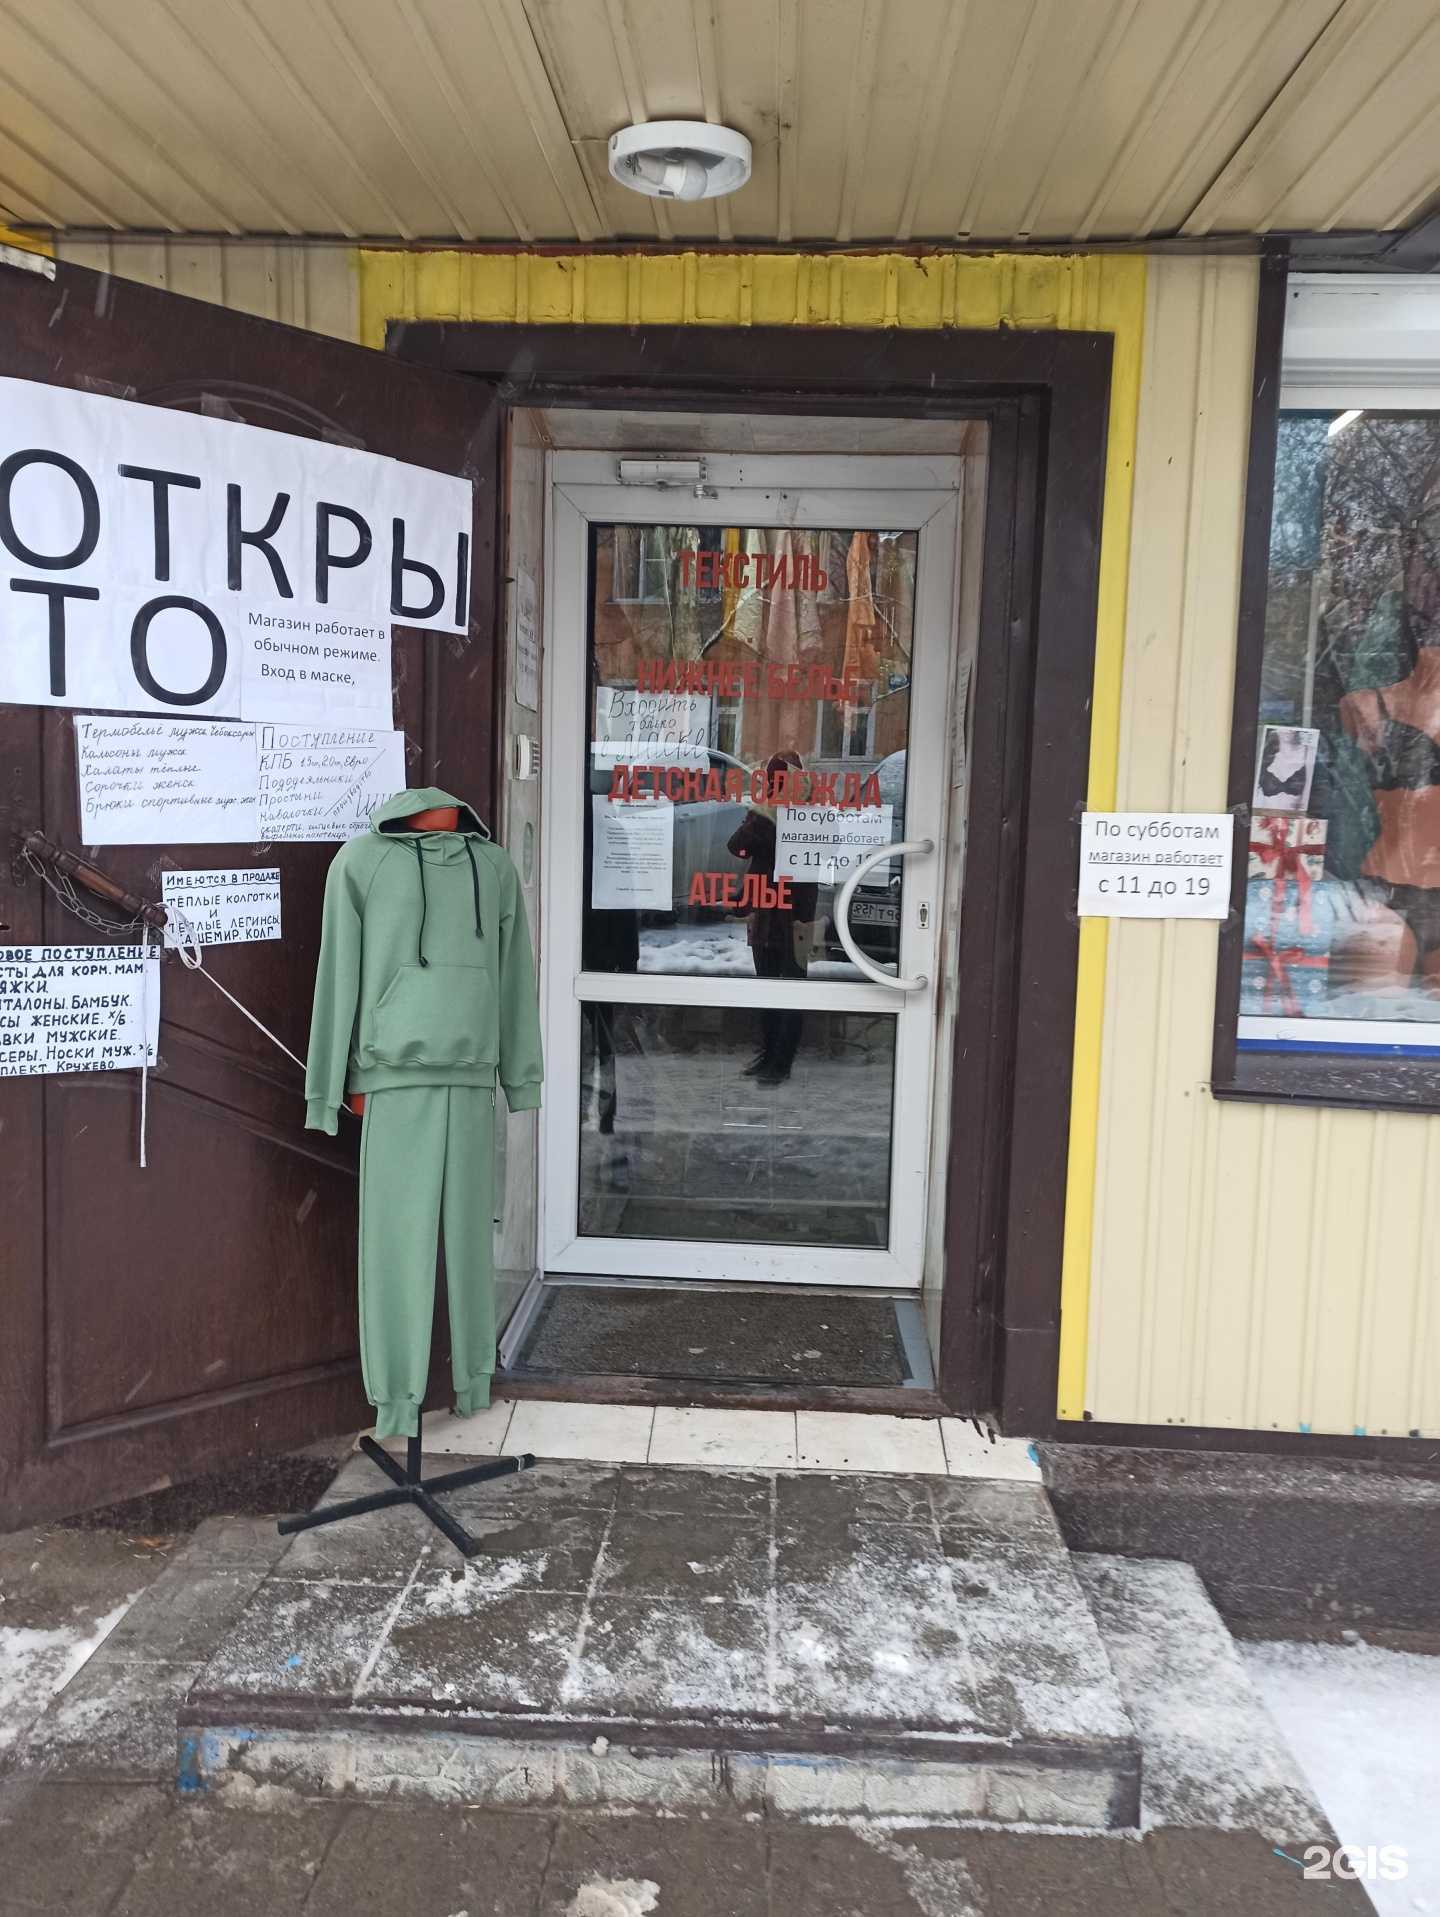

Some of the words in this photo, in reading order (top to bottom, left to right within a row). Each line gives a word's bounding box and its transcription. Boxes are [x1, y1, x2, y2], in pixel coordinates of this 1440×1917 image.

[0, 449, 468, 627] ОТКРЫ
[678, 551, 828, 592] ТЕКСТИЛЬ
[248, 612, 310, 631] Магазин
[315, 622, 375, 638] работает
[378, 630, 385, 640] в
[10, 577, 227, 706] ТО
[254, 638, 319, 656] обычном
[323, 647, 380, 662] режиме.
[261, 663, 295, 681] Вход
[299, 670, 307, 680] в
[311, 670, 355, 687] маске,
[637, 657, 760, 699] НИЖНЕЕ
[766, 663, 860, 703] БЕЛЬЕ
[608, 690, 698, 720] Входить
[259, 752, 293, 771] КПБ
[608, 764, 743, 803] ДЕТСКАЯ
[751, 768, 882, 811] ОДЕЖДА
[786, 808, 807, 822] По
[782, 831, 829, 842] магазин
[832, 832, 886, 845] работает
[1096, 820, 1121, 837] По
[1127, 821, 1220, 840] субботам
[789, 854, 798, 865] с
[803, 851, 822, 866] 11
[827, 855, 850, 870] до
[1088, 851, 1151, 863] магазин
[1155, 850, 1225, 865] работает
[166, 875, 226, 886] ИМЕЮТСЯ
[231, 873, 238, 883] В
[242, 871, 280, 882] ПРОДАЖЕ
[1098, 878, 1109, 893] с
[1116, 875, 1141, 894] 11
[1147, 880, 1177, 898] до
[1185, 877, 1211, 896] 19
[226, 892, 280, 904] КОЛГОТКИ
[688, 872, 794, 910] АТЕЛЬЕ
[209, 909, 218, 919] И
[230, 915, 280, 929] ЛЕГИНСЫ
[180, 929, 241, 945] АШЕМИР.
[32, 965, 64, 979] ДЛЯ
[0, 997, 68, 1011] ТАЛОНЫ.
[31, 1012, 104, 1027] ЖЕНСКИЕ.
[0, 1032, 35, 1046] ВКИ
